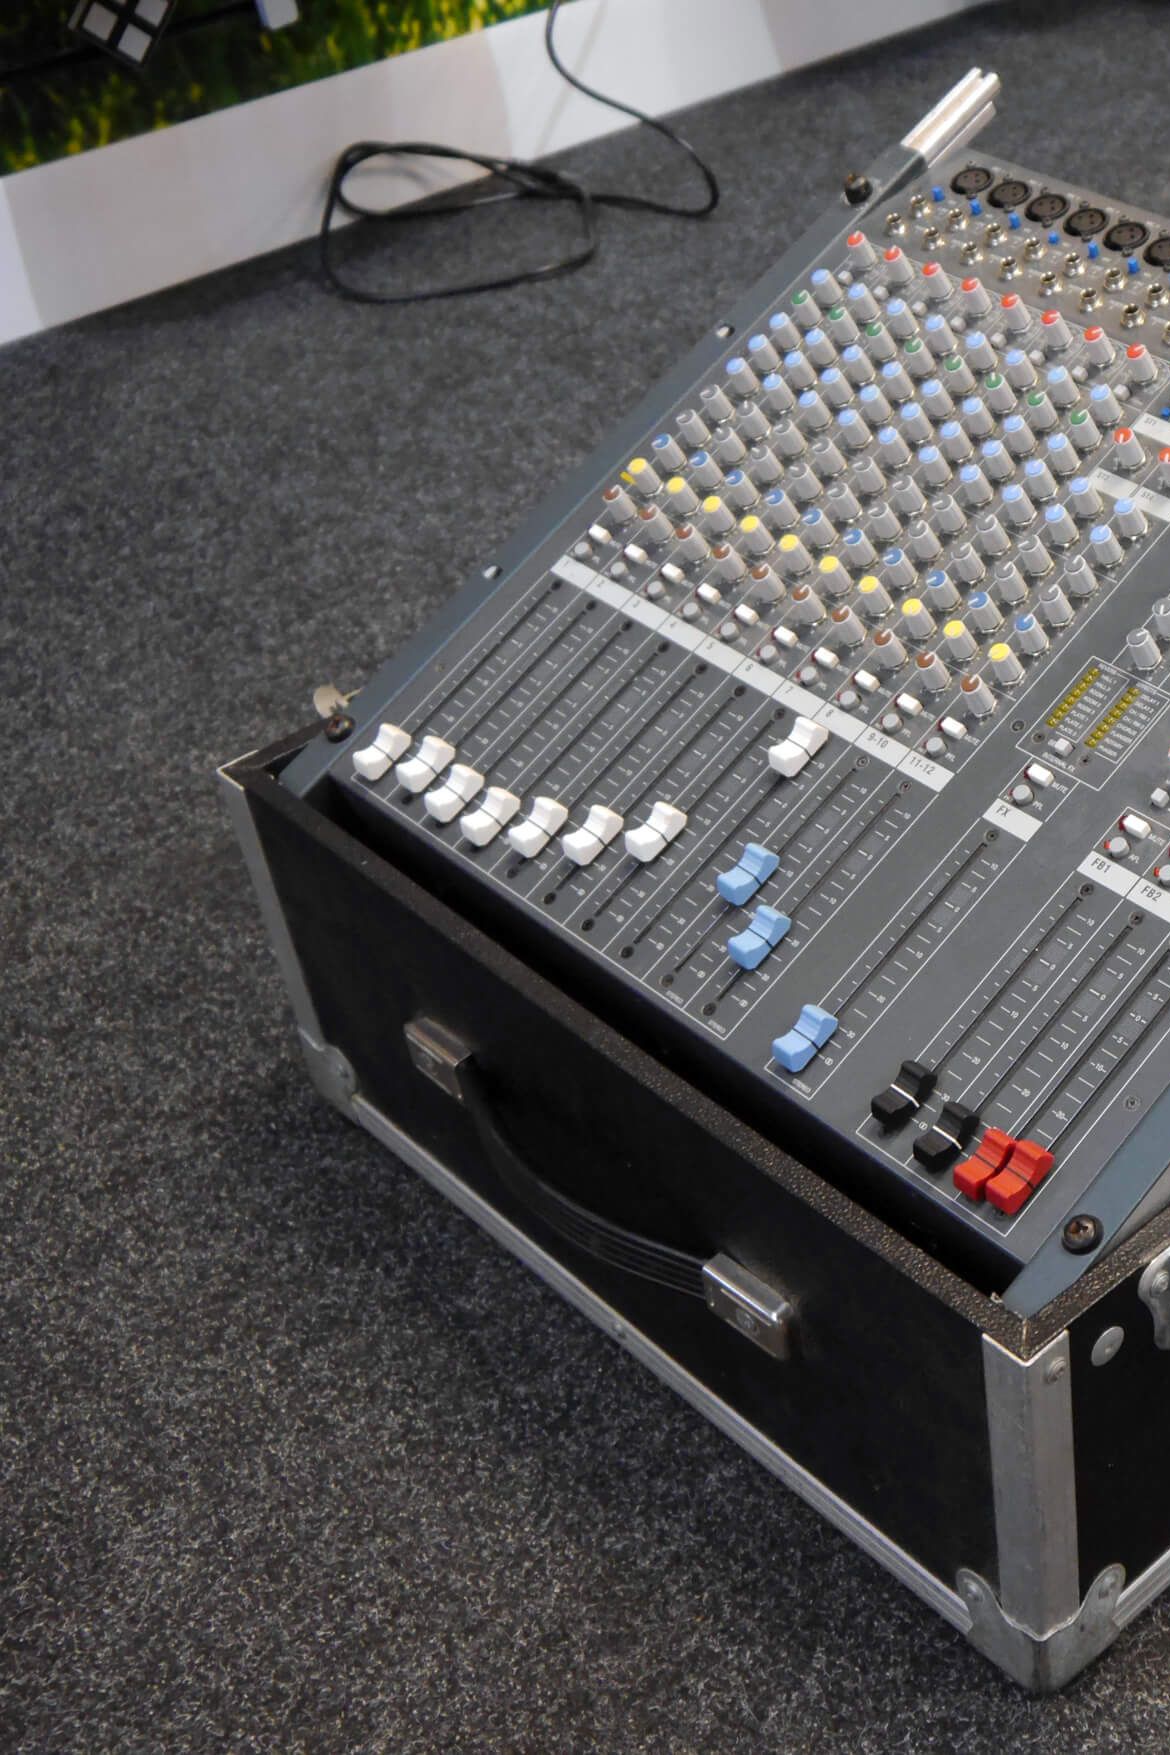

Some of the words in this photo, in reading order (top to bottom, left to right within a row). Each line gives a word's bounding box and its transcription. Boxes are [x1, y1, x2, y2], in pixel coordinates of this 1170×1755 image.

[867, 733, 889, 749] 9-10
[909, 757, 936, 775] 11-12
[996, 804, 1011, 817] FX
[1091, 858, 1111, 873] FB1
[1140, 885, 1163, 902] FB2
